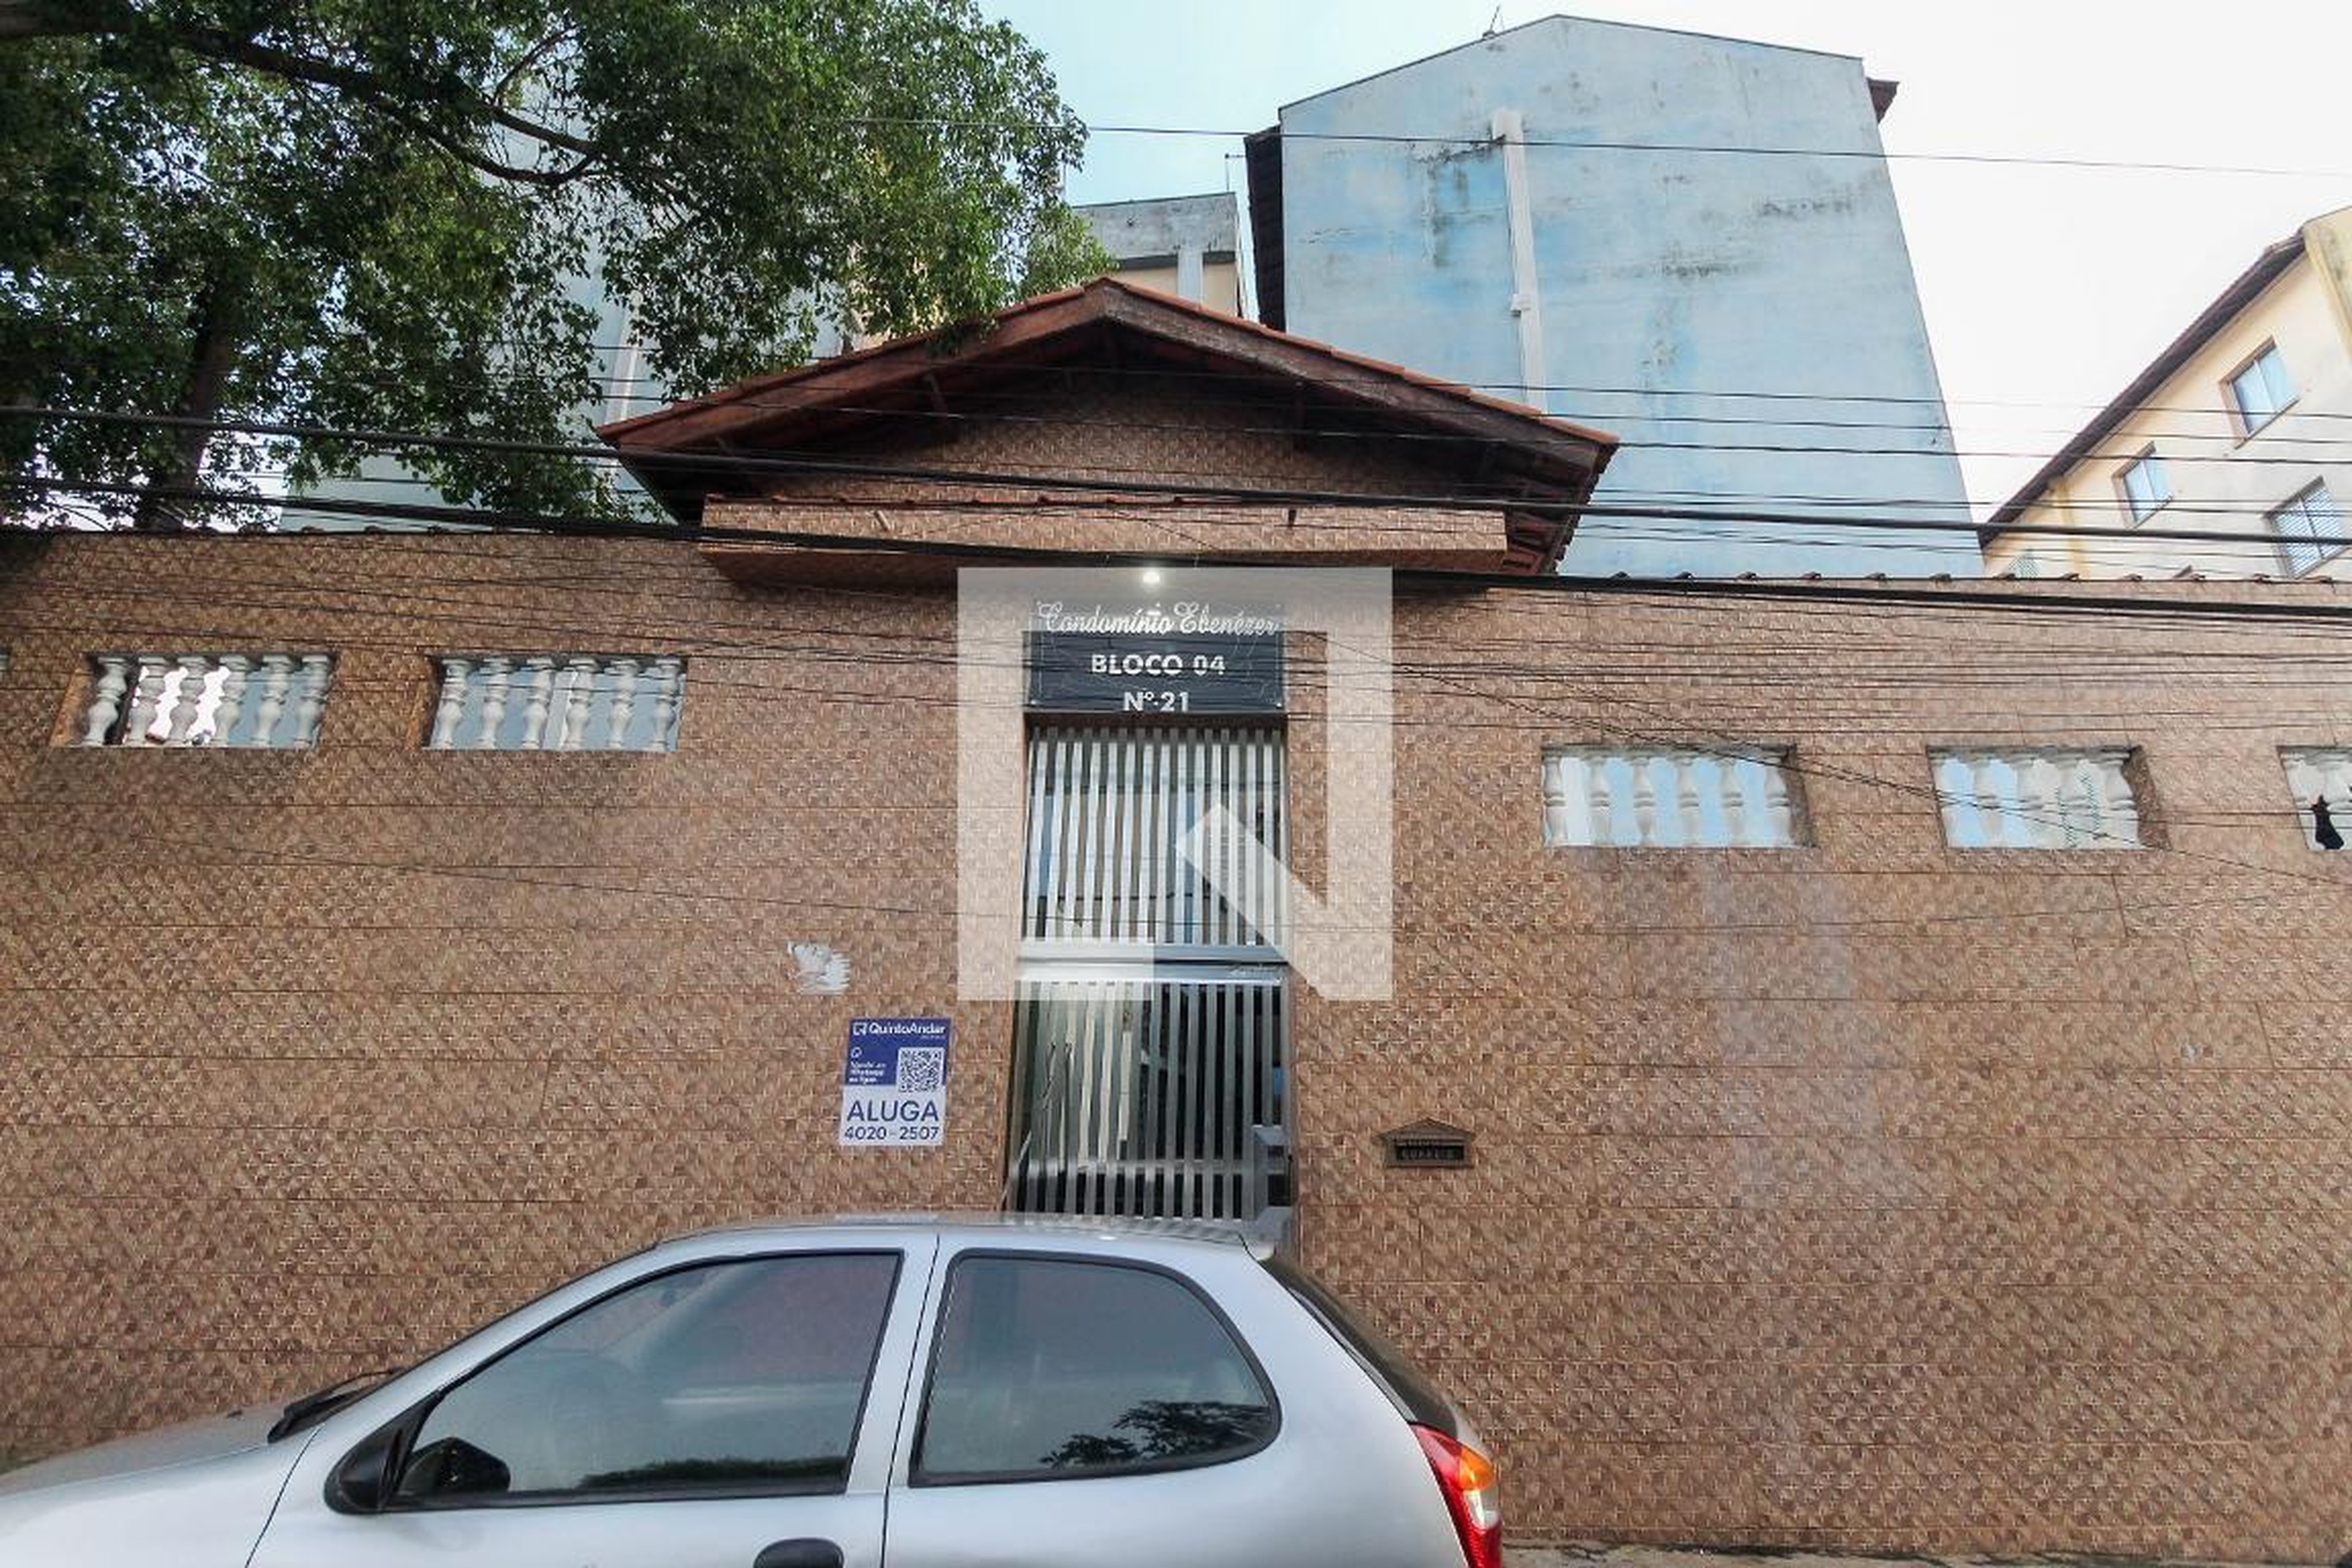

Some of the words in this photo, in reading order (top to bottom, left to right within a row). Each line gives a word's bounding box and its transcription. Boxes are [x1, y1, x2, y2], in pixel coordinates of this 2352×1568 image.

[1036, 601, 1175, 633] Condomínio
[1091, 654, 1183, 674] BLOCO
[1194, 655, 1225, 674] 04
[869, 1022, 946, 1034] QuintoAndar
[846, 1100, 939, 1121] ALUGA
